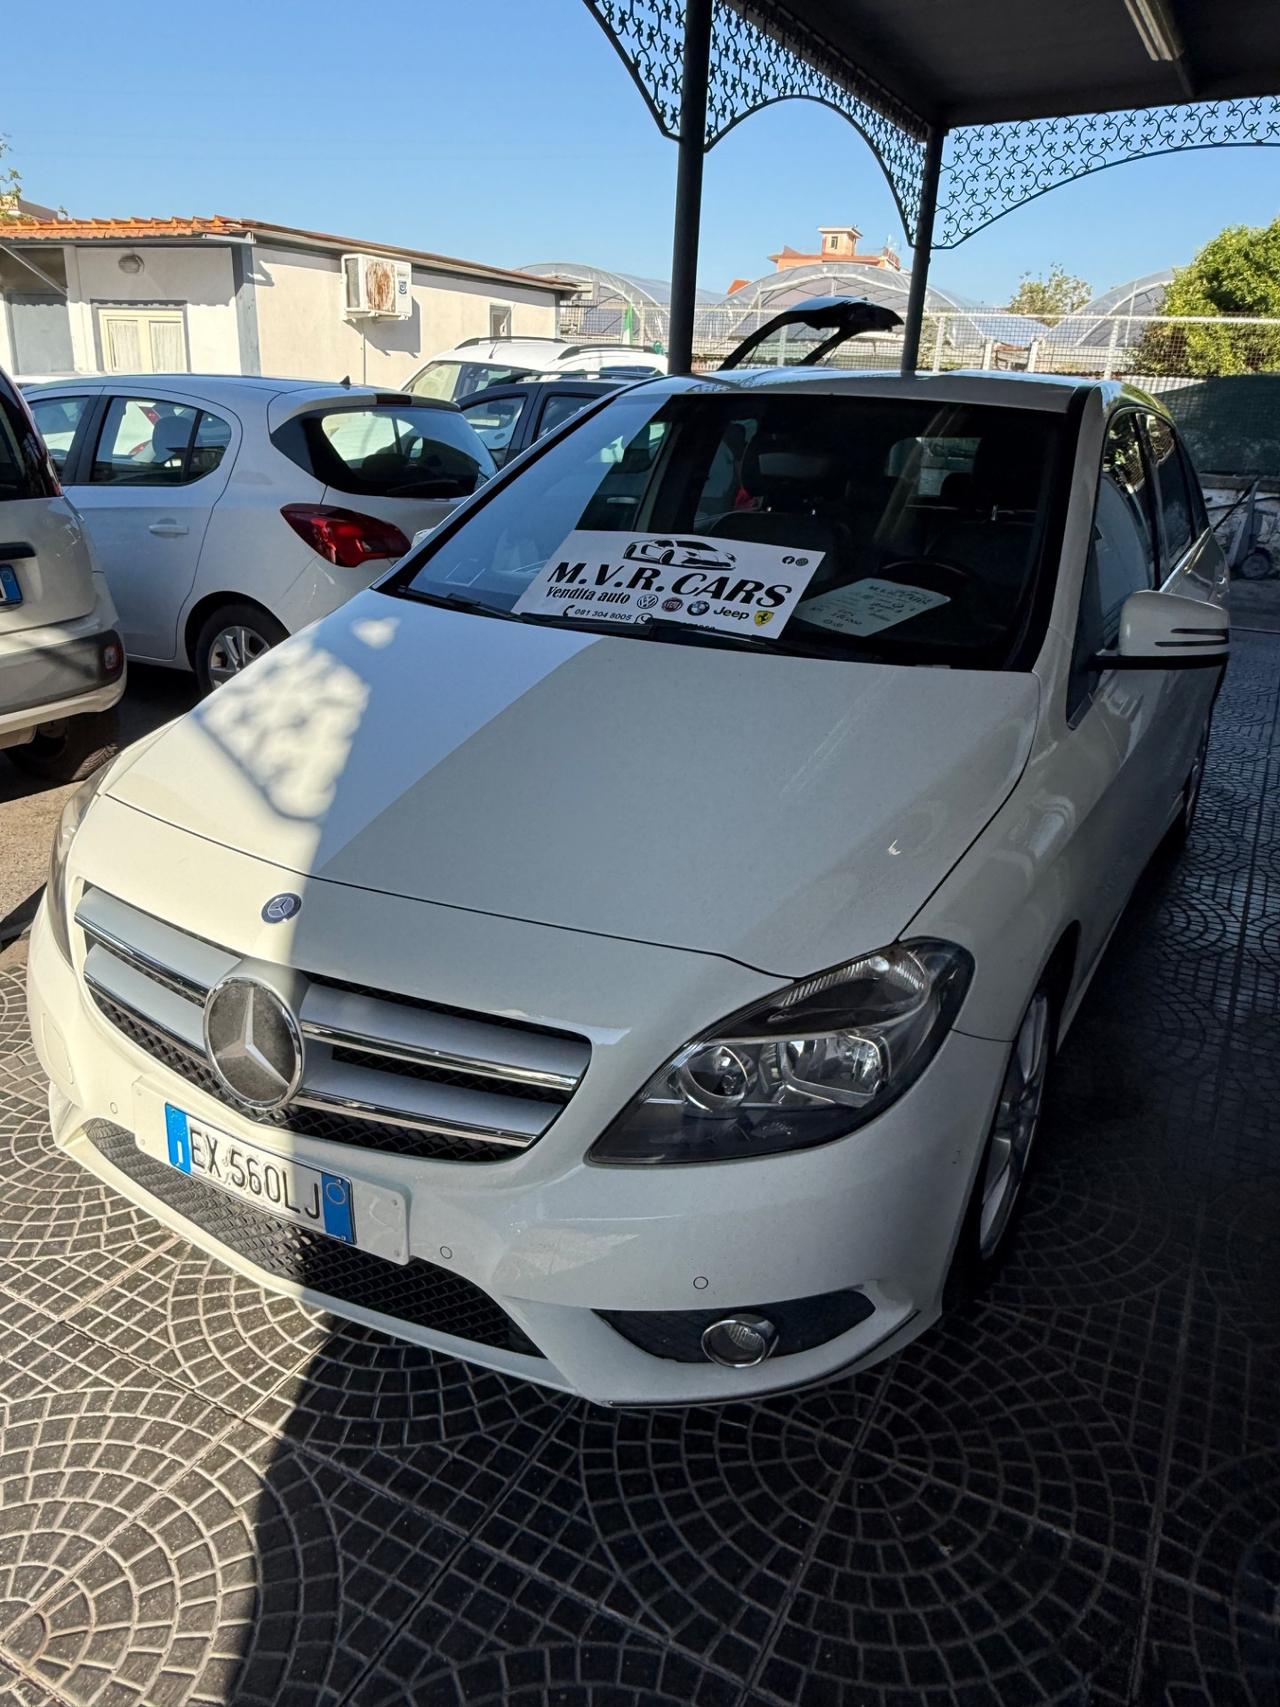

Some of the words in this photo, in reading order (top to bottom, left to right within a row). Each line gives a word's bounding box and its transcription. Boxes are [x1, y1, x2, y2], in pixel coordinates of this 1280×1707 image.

[546, 586, 596, 601] Vendita
[597, 590, 631, 605] auto
[574, 608, 591, 616] 081
[713, 606, 750, 620] Jeep
[190, 1129, 221, 1178] EX
[230, 1151, 321, 1219] 560LJ
